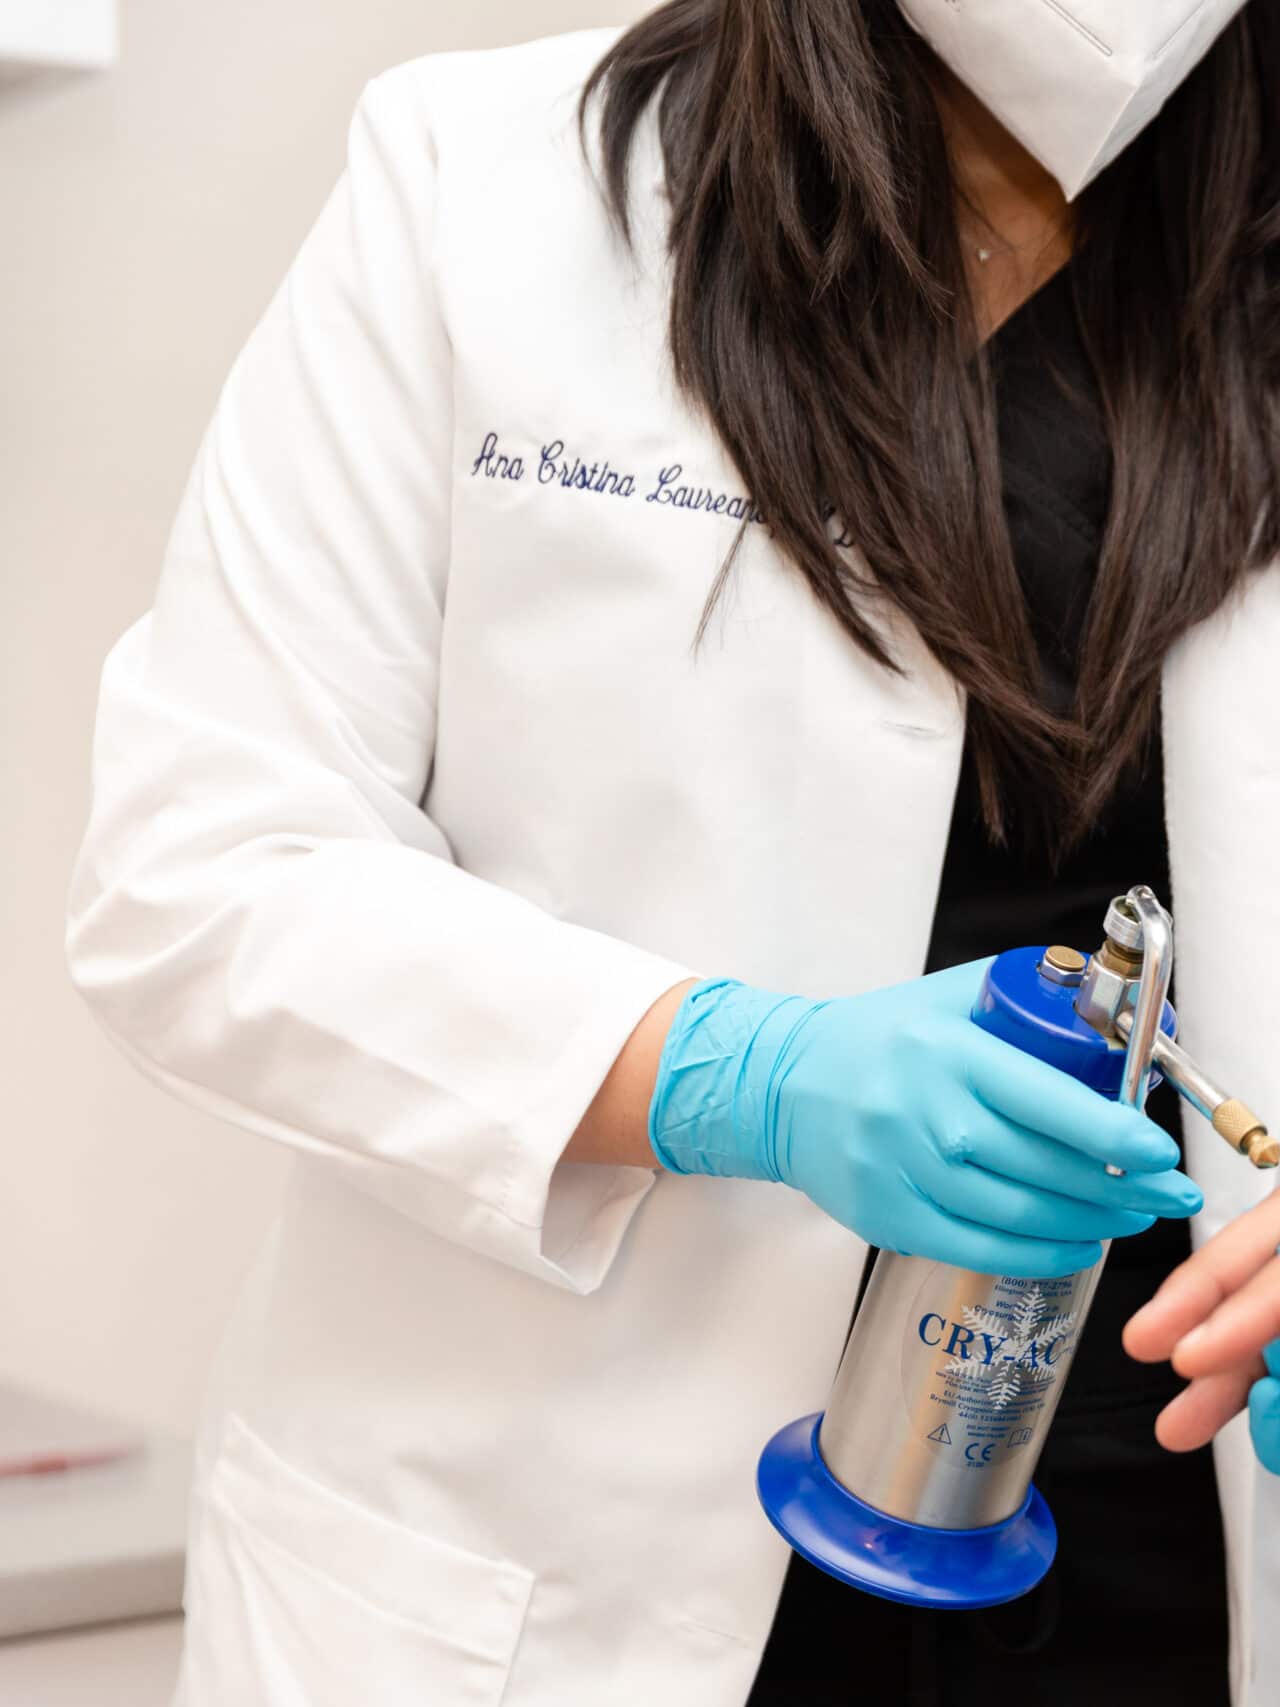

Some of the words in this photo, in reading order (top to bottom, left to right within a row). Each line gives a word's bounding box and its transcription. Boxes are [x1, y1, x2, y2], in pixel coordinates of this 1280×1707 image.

[472, 432, 525, 479] Ana
[537, 440, 636, 496] Cristina
[917, 1312, 1065, 1369] CRY-AC
[964, 1442, 997, 1461] CE
